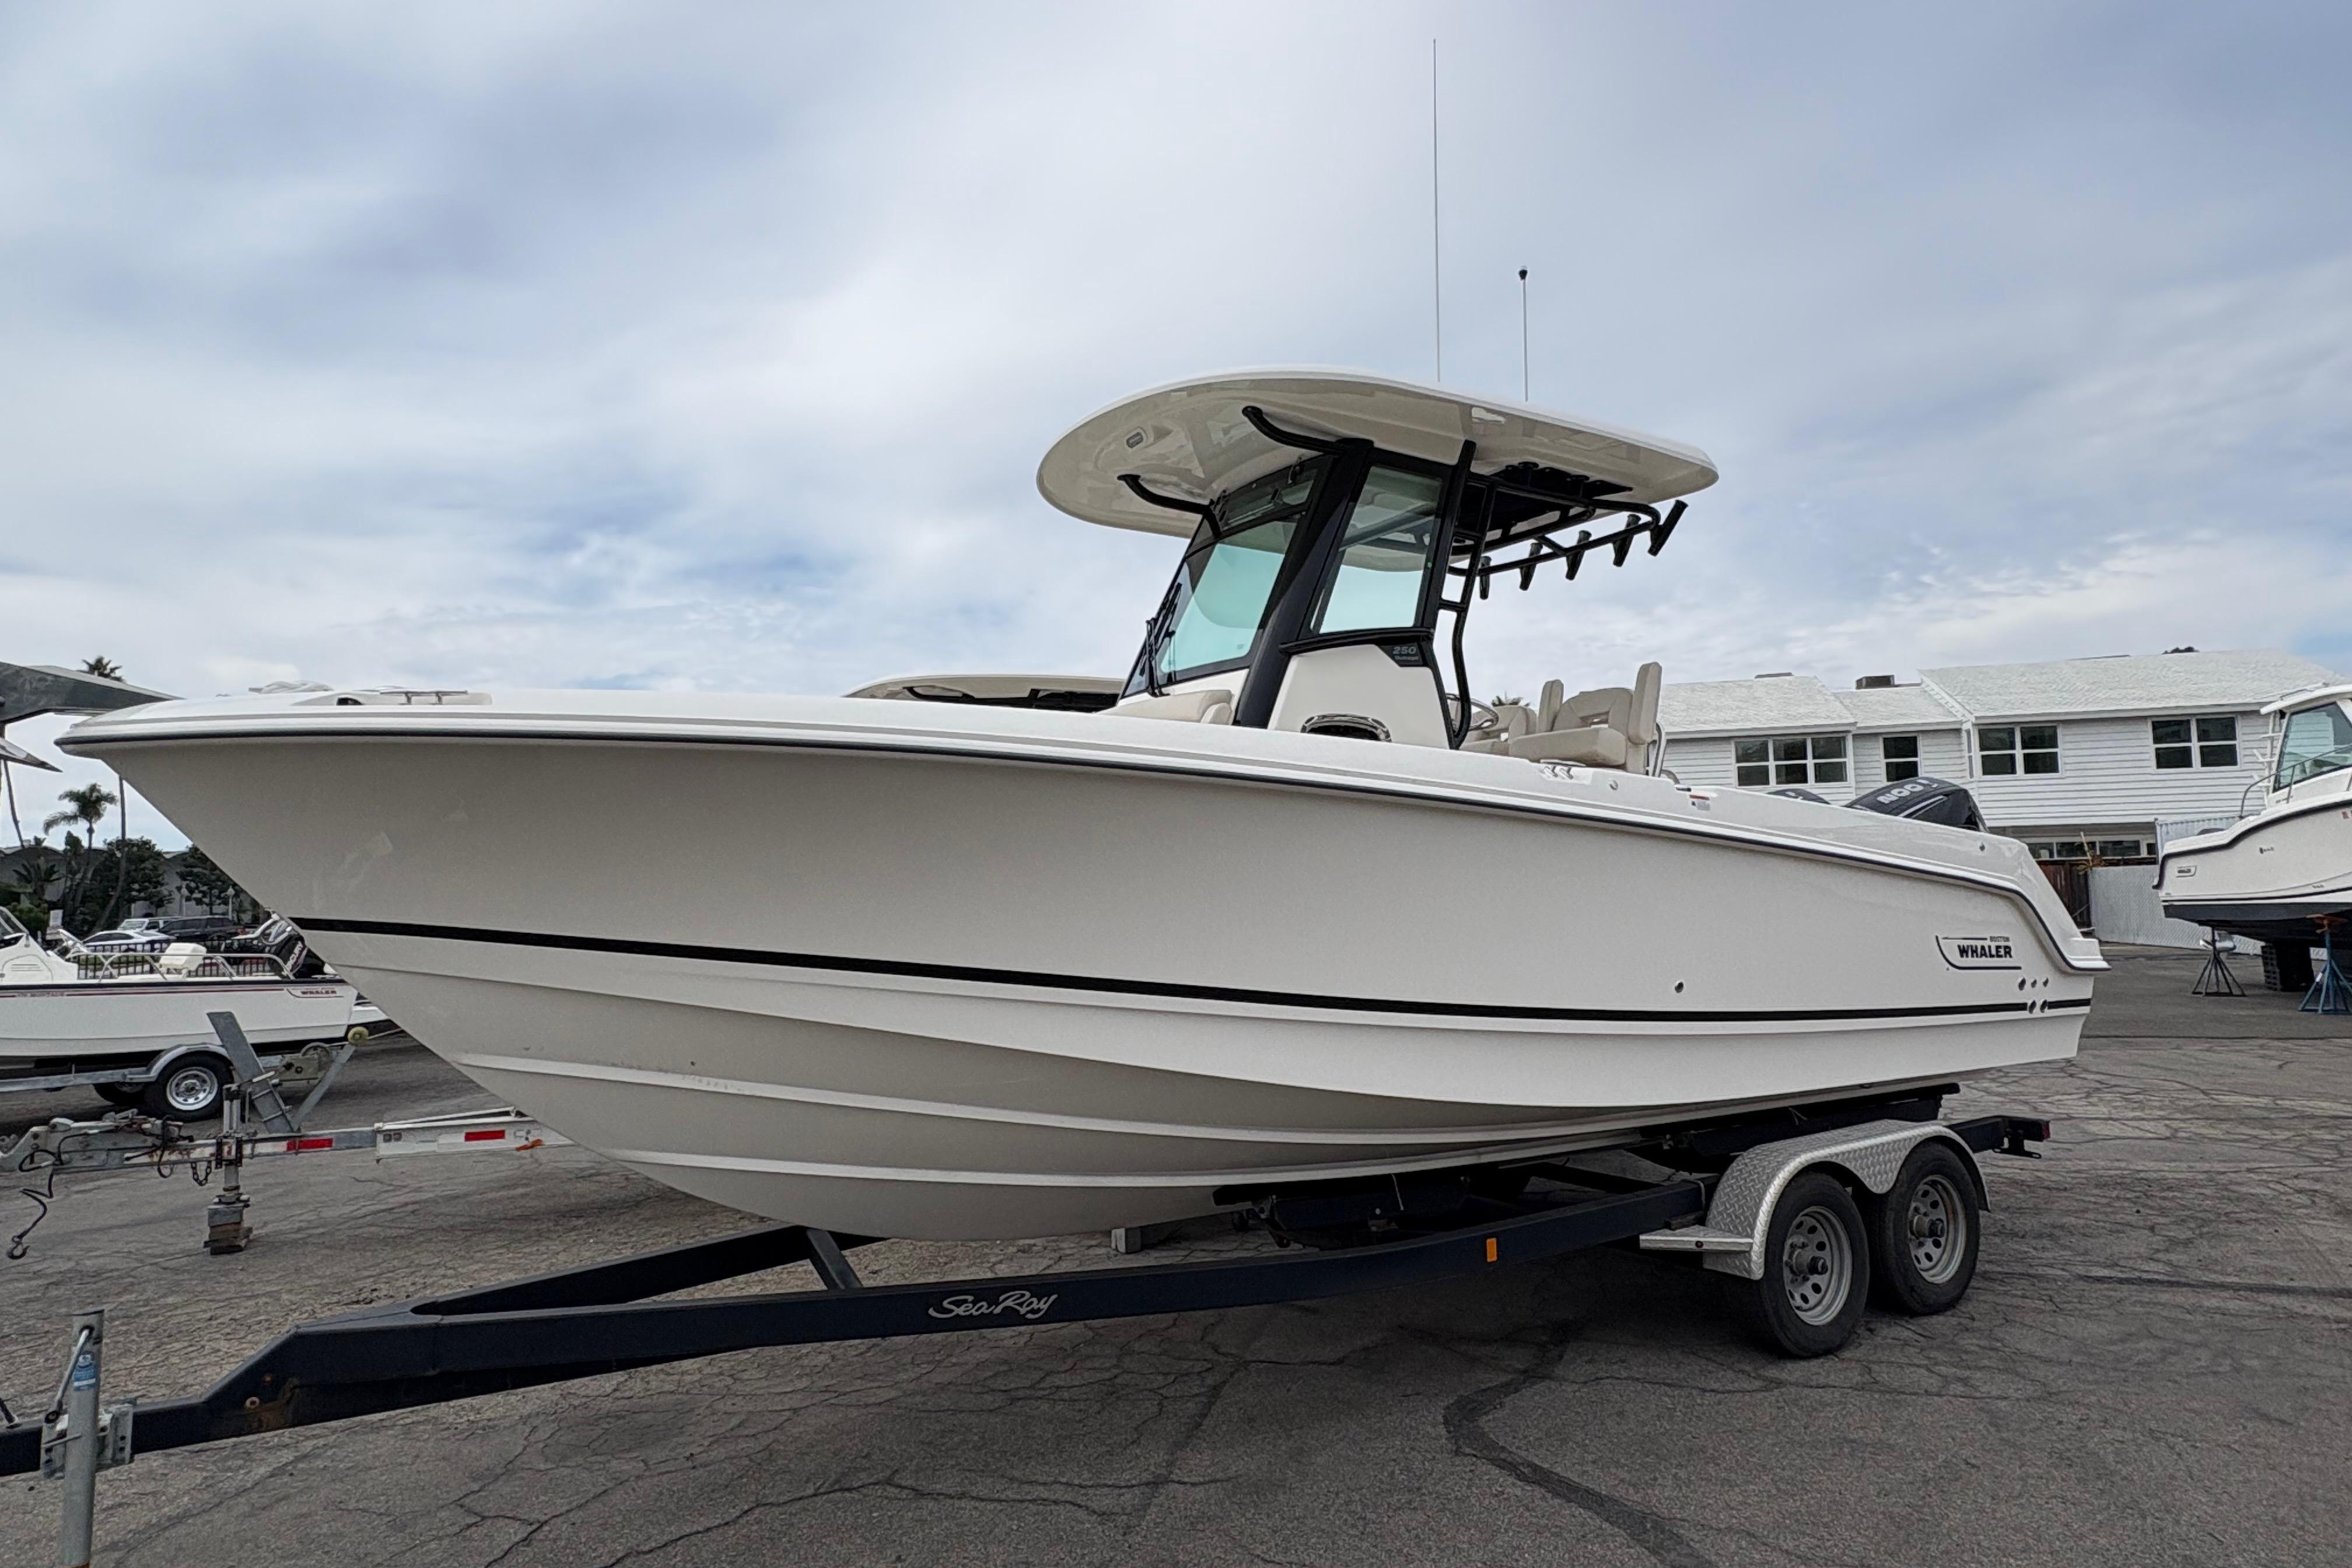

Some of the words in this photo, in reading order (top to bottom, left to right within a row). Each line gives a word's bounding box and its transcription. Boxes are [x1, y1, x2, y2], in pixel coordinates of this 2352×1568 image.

[1957, 944, 2013, 959] WHALER
[928, 1295, 995, 1318] Sea
[993, 1290, 1058, 1320] Ray
